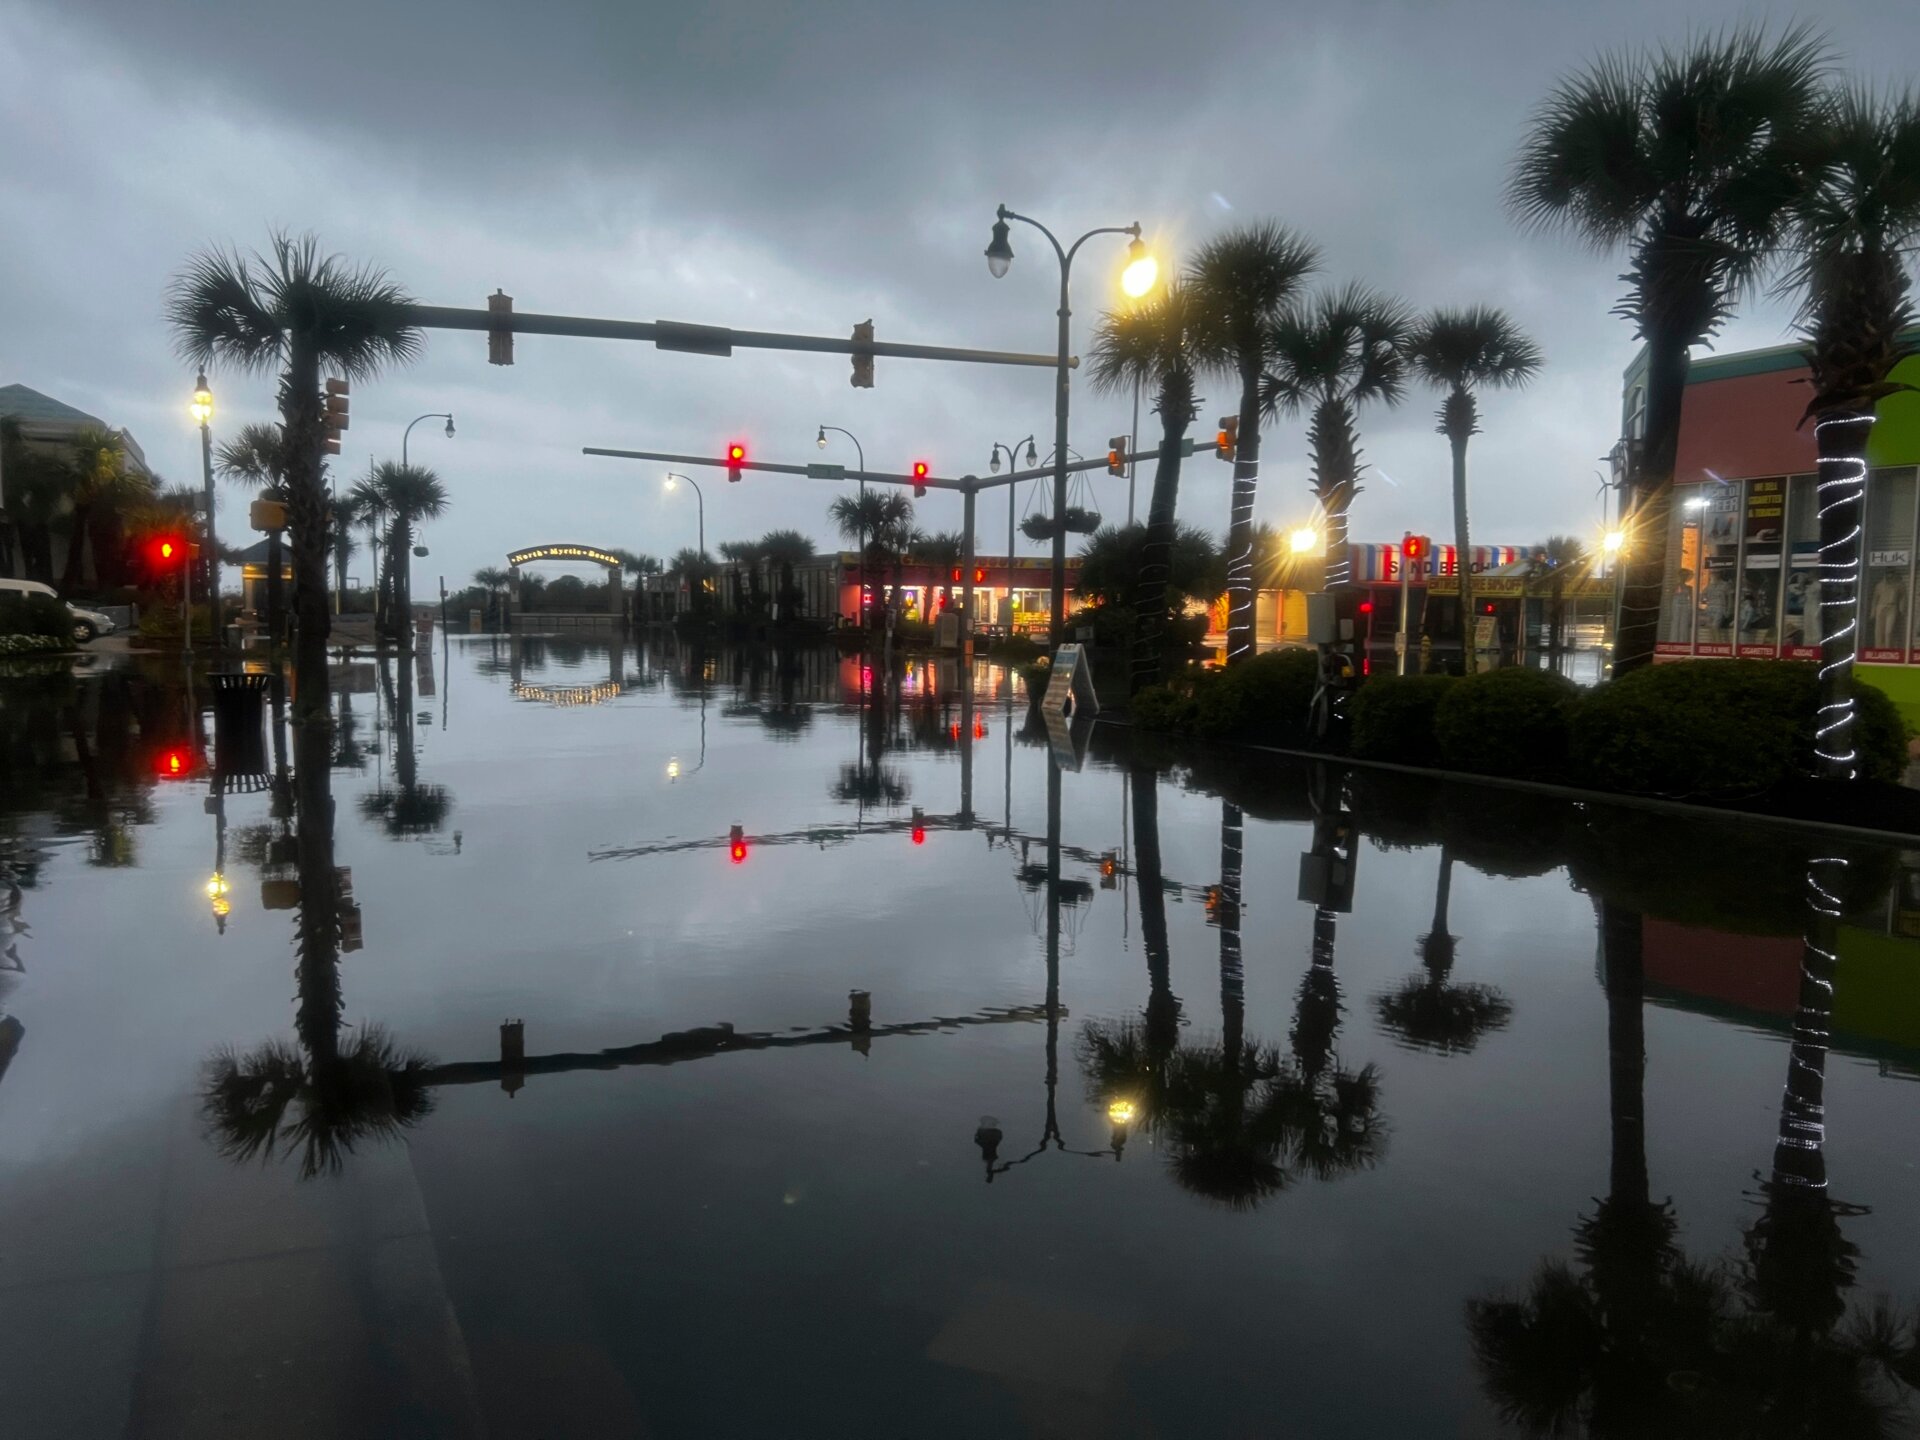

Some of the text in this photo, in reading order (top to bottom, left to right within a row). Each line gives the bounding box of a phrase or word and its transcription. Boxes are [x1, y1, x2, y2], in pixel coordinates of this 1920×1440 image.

[516, 548, 616, 563] North Myrtle Beach
[1440, 561, 1491, 575] BECH
[1741, 647, 1774, 656] CIGARETTES
